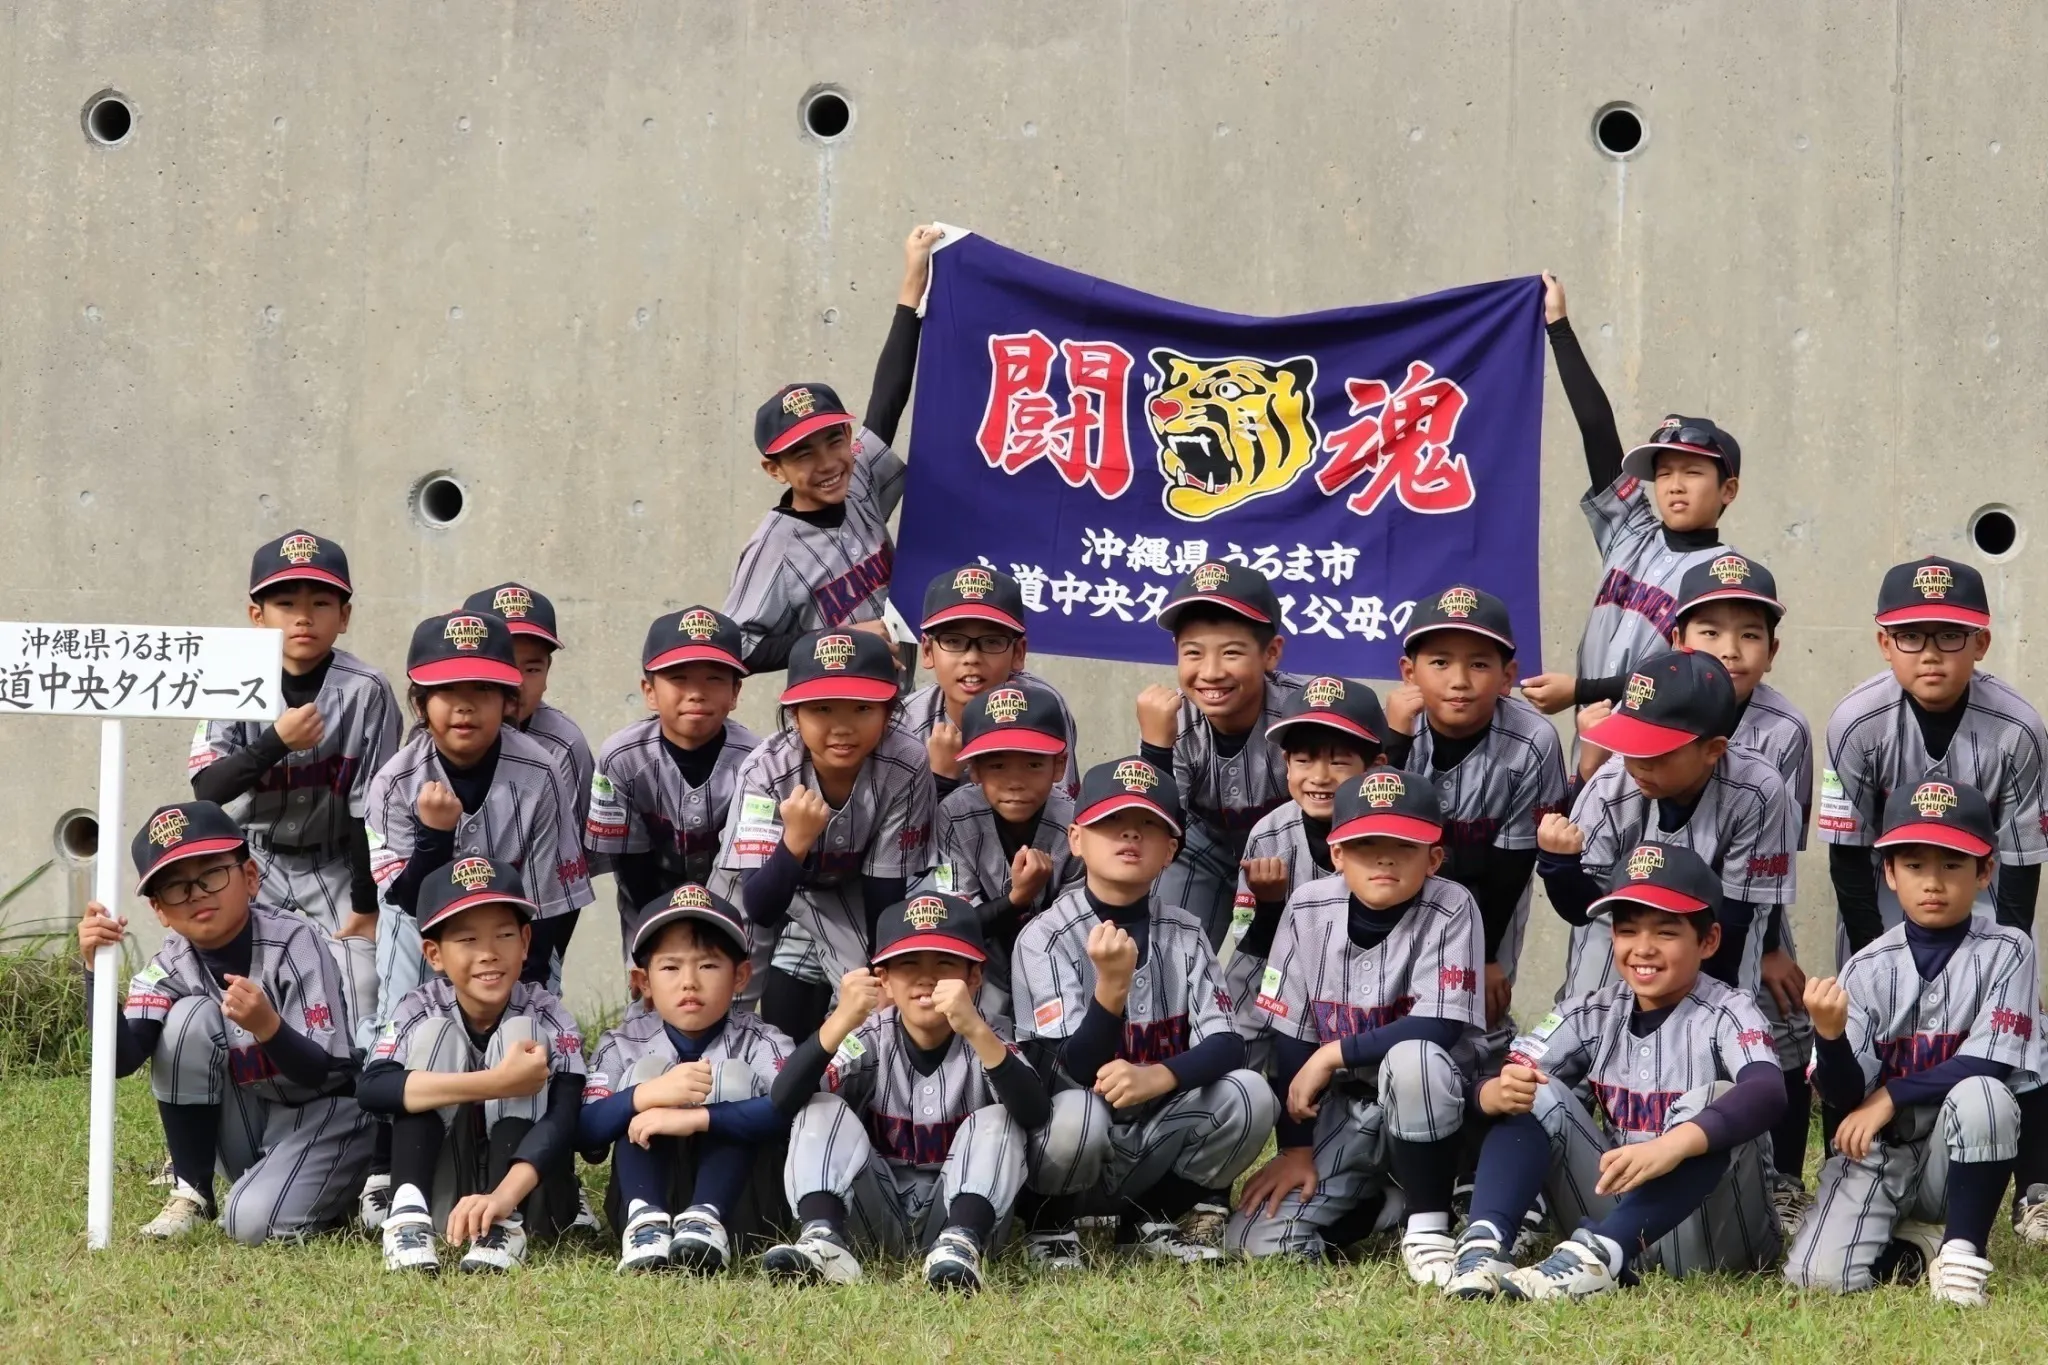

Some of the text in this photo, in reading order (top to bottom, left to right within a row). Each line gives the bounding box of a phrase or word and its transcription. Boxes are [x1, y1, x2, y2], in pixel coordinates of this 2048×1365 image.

[974, 329, 1476, 516] 闘 魂
[289, 550, 312, 560] CHUO
[1081, 527, 1361, 586] 沖縄県うるま市
[1193, 570, 1229, 583] KAMICHI
[1718, 571, 1744, 581] CHUO
[952, 577, 994, 591] AKAMICHI
[1197, 577, 1219, 587] CHUO
[960, 586, 986, 596] CHUO
[1921, 584, 1948, 595] CHUO
[503, 604, 528, 614] CHUO
[1445, 603, 1471, 613] CHUO
[444, 626, 488, 639] AKAMICHI
[687, 626, 712, 636] CHUO
[21, 626, 204, 664] 沖縄県うるま市
[454, 635, 480, 646] CHUO
[821, 654, 848, 664] CHUO
[0, 661, 268, 710] 道中央タイガース
[1309, 693, 1335, 703] CHUO
[985, 699, 1028, 714] AKAMICHI
[992, 707, 1019, 718] CHUO
[1113, 767, 1159, 786] AKAMICHI
[1123, 776, 1150, 788] CHUO
[1359, 782, 1406, 796] AKAMICHI
[1367, 792, 1396, 803] CHUO
[1911, 792, 1958, 808] AKAMICHI
[1918, 801, 1947, 813] CHUO
[149, 815, 189, 844] AKAMICHI
[1832, 819, 1854, 830] PLAYER
[158, 827, 182, 845] CHUO
[1629, 855, 1665, 868] KAMICHI
[1629, 863, 1652, 874] CHUO
[461, 875, 488, 886] CHUO
[903, 904, 948, 921] AKAMICHI
[912, 915, 939, 925] CHUO
[144, 996, 169, 1006] PLAYER
